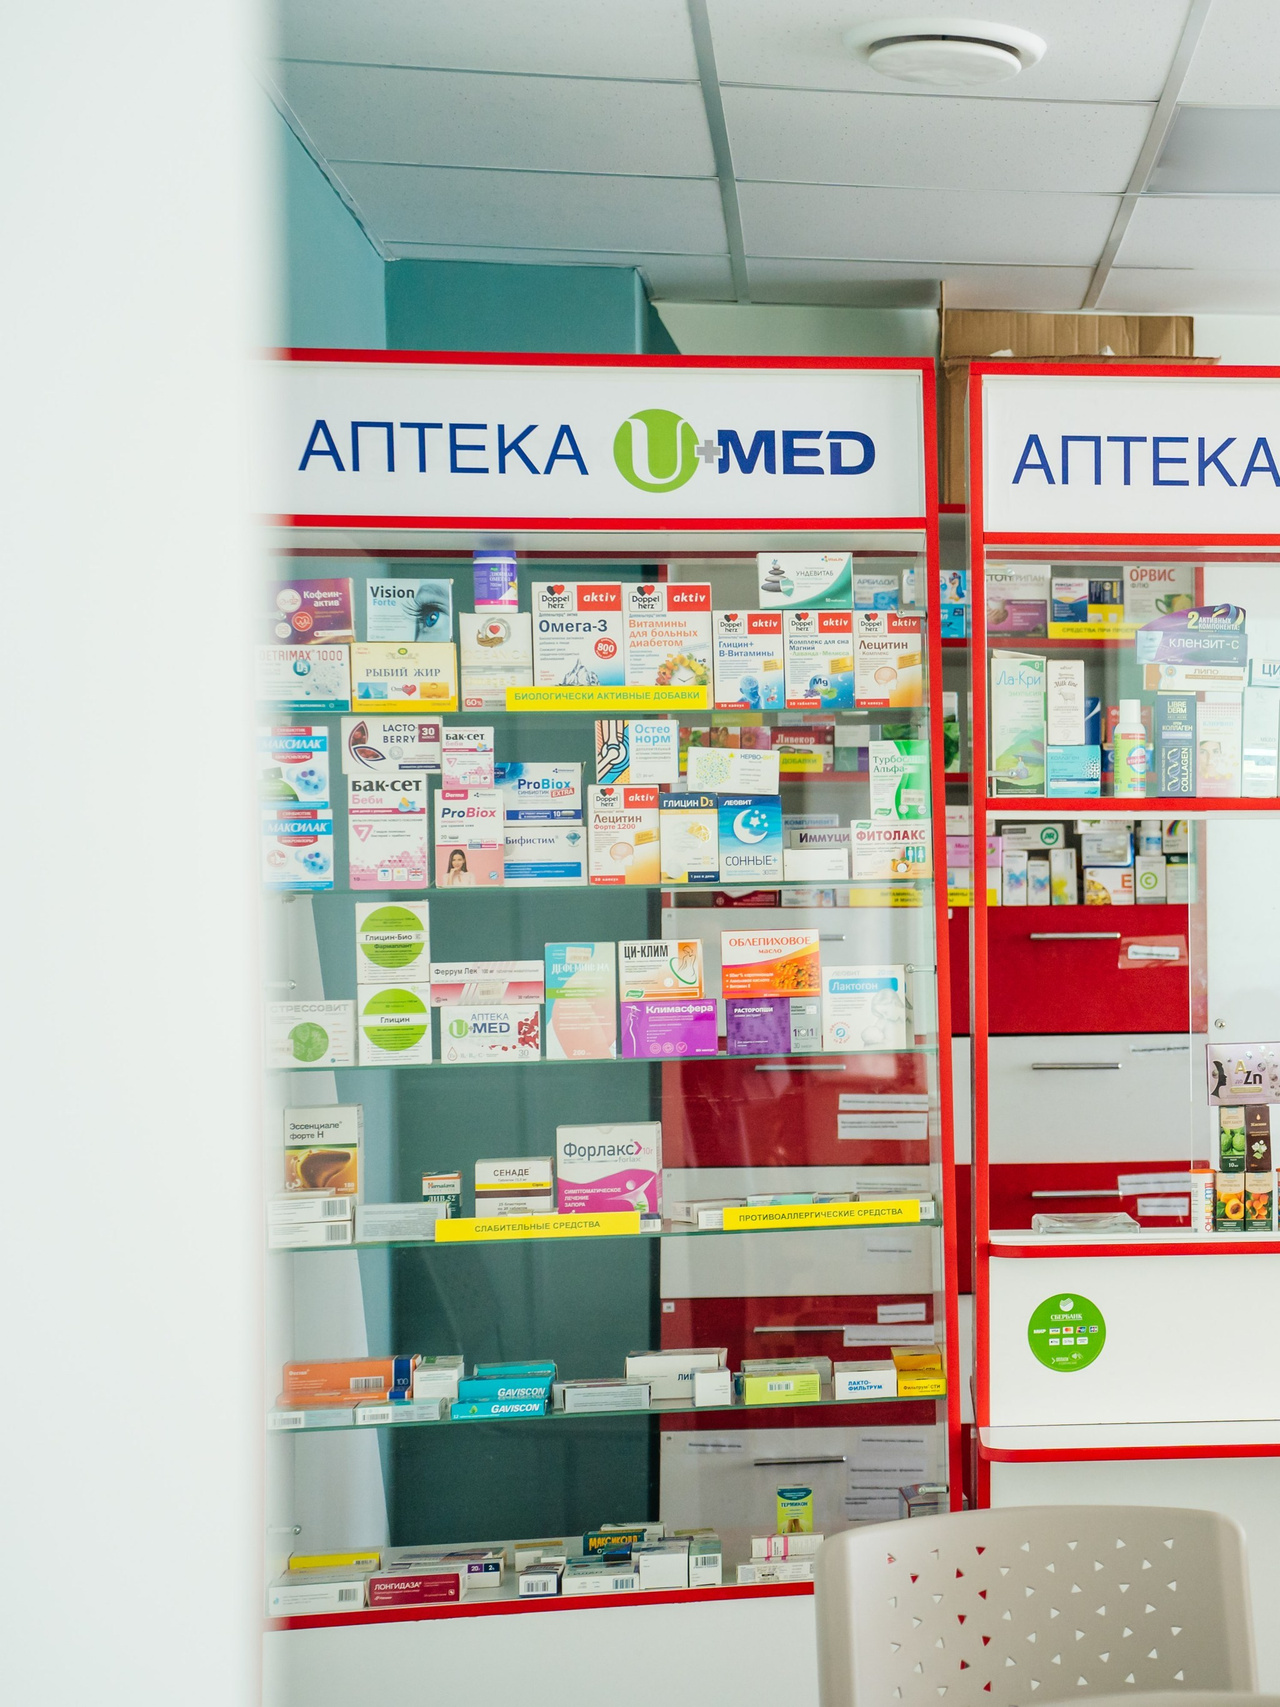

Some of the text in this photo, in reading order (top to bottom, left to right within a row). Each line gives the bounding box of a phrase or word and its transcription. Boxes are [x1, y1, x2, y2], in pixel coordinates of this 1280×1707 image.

[298, 419, 589, 476] АПТЕКА
[1130, 568, 1175, 582] ОРВИС
[370, 586, 415, 599] Vision
[584, 592, 616, 602] aktiv
[673, 592, 706, 602] aktiv
[539, 620, 607, 632] Омега-3
[629, 620, 686, 628] Витамины
[629, 629, 698, 639] для больных
[629, 639, 683, 648] диабетом
[859, 640, 908, 651] Лецитин
[365, 668, 440, 678] РЫБИЙ ЖИР
[996, 670, 1041, 686] Ла-Кри
[515, 692, 700, 700] БИОЛОГИЧЕСКИ АКТИВНЫЕ ДОБАВКИ
[422, 728, 434, 736] 30
[635, 725, 670, 734] Остео
[383, 735, 416, 743] BERRY
[635, 735, 671, 745] норм
[518, 779, 571, 790] ProBiox
[352, 794, 383, 804] Беби
[663, 799, 699, 807] ГЛИЦИН
[442, 808, 496, 818] ProBiox
[594, 815, 642, 824] Лецитин
[856, 830, 925, 840] ФИТОЛАКС
[365, 934, 412, 942] Глицин-Био
[729, 937, 811, 947] ОБЛЕПИХОВОЕ
[624, 945, 668, 959] ЦИ-КЛИМ
[832, 982, 878, 992] Лактогон
[646, 1005, 713, 1014] Климасфера
[564, 1143, 634, 1160] Форлакс
[739, 1208, 902, 1222] ПРОТИВОАЛЛЕРГИЧЕСКИЕ СРЕДСТВА
[475, 1221, 600, 1232] СЛАБИТЕЛЬНЫЕ СРЕДСТВА
[491, 1404, 539, 1413] GAVISCON
